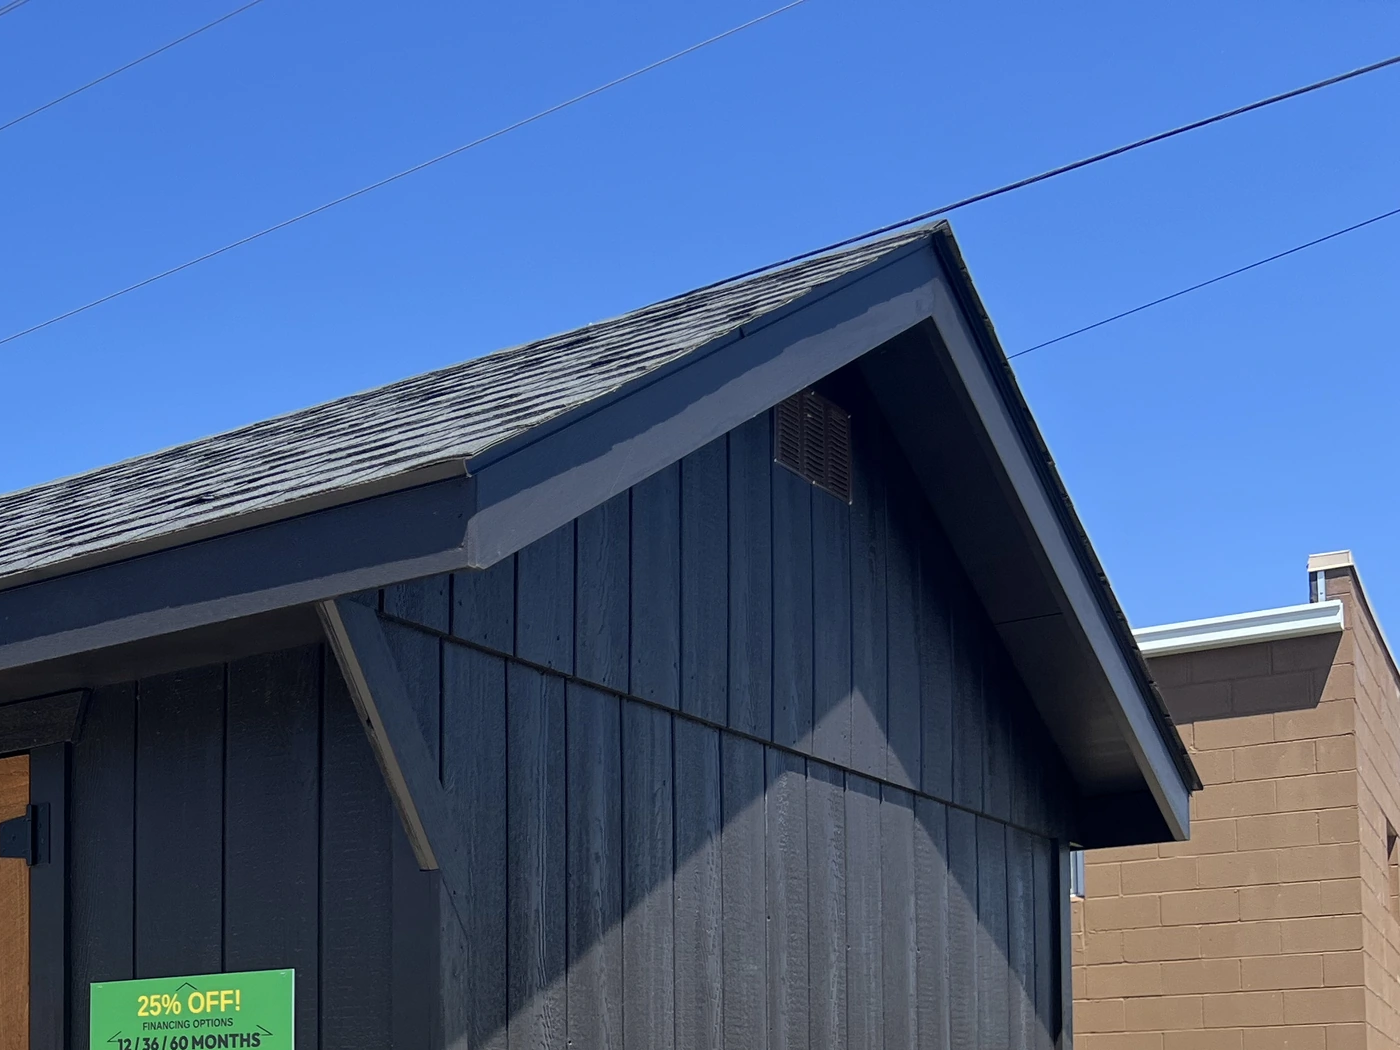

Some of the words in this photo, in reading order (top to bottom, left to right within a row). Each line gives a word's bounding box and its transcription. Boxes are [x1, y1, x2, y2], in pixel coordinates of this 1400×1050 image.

[137, 993, 182, 1017] 25%
[188, 989, 241, 1014] OFF!
[142, 1019, 191, 1031] FINANCING
[193, 1017, 234, 1029] OPTIONS
[170, 1036, 189, 1050] 60
[191, 1032, 261, 1050] MONTHS
